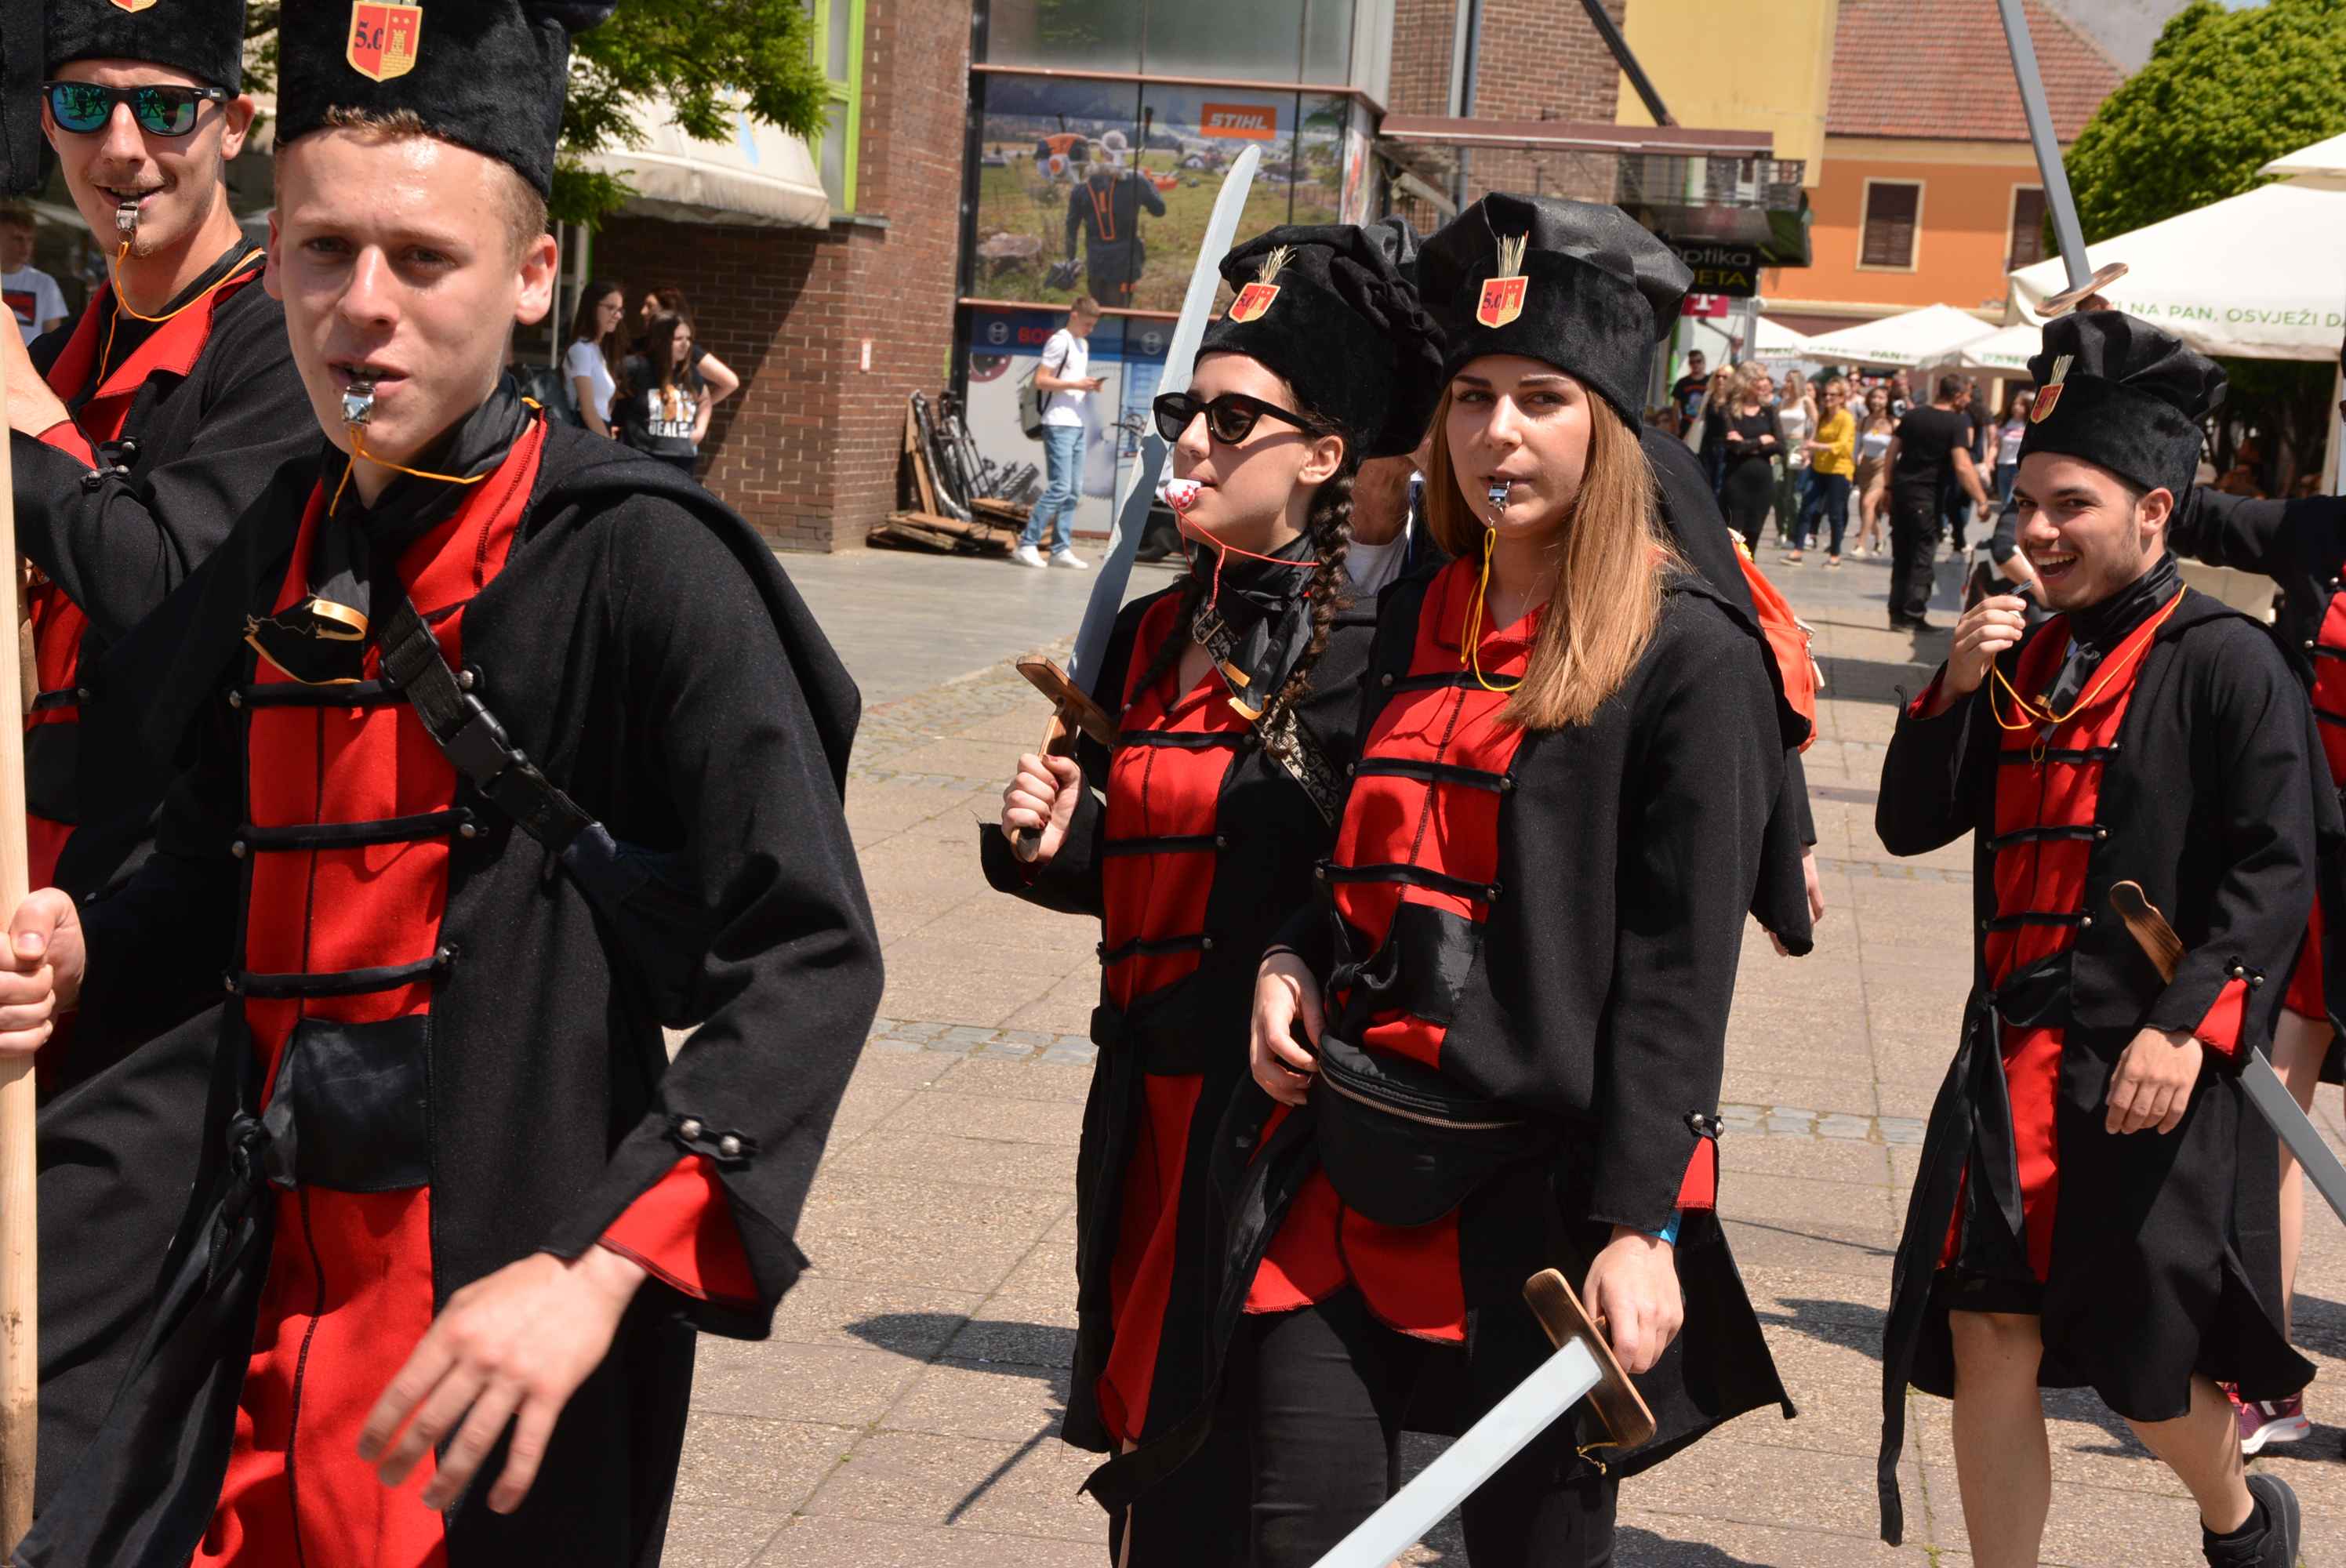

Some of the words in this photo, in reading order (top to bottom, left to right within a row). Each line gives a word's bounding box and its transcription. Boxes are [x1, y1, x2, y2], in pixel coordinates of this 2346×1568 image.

[1208, 113, 1268, 129] STIHL
[1694, 270, 1749, 288] ETA
[2130, 303, 2160, 315] NA
[2226, 308, 2317, 326] OSVJEŽI
